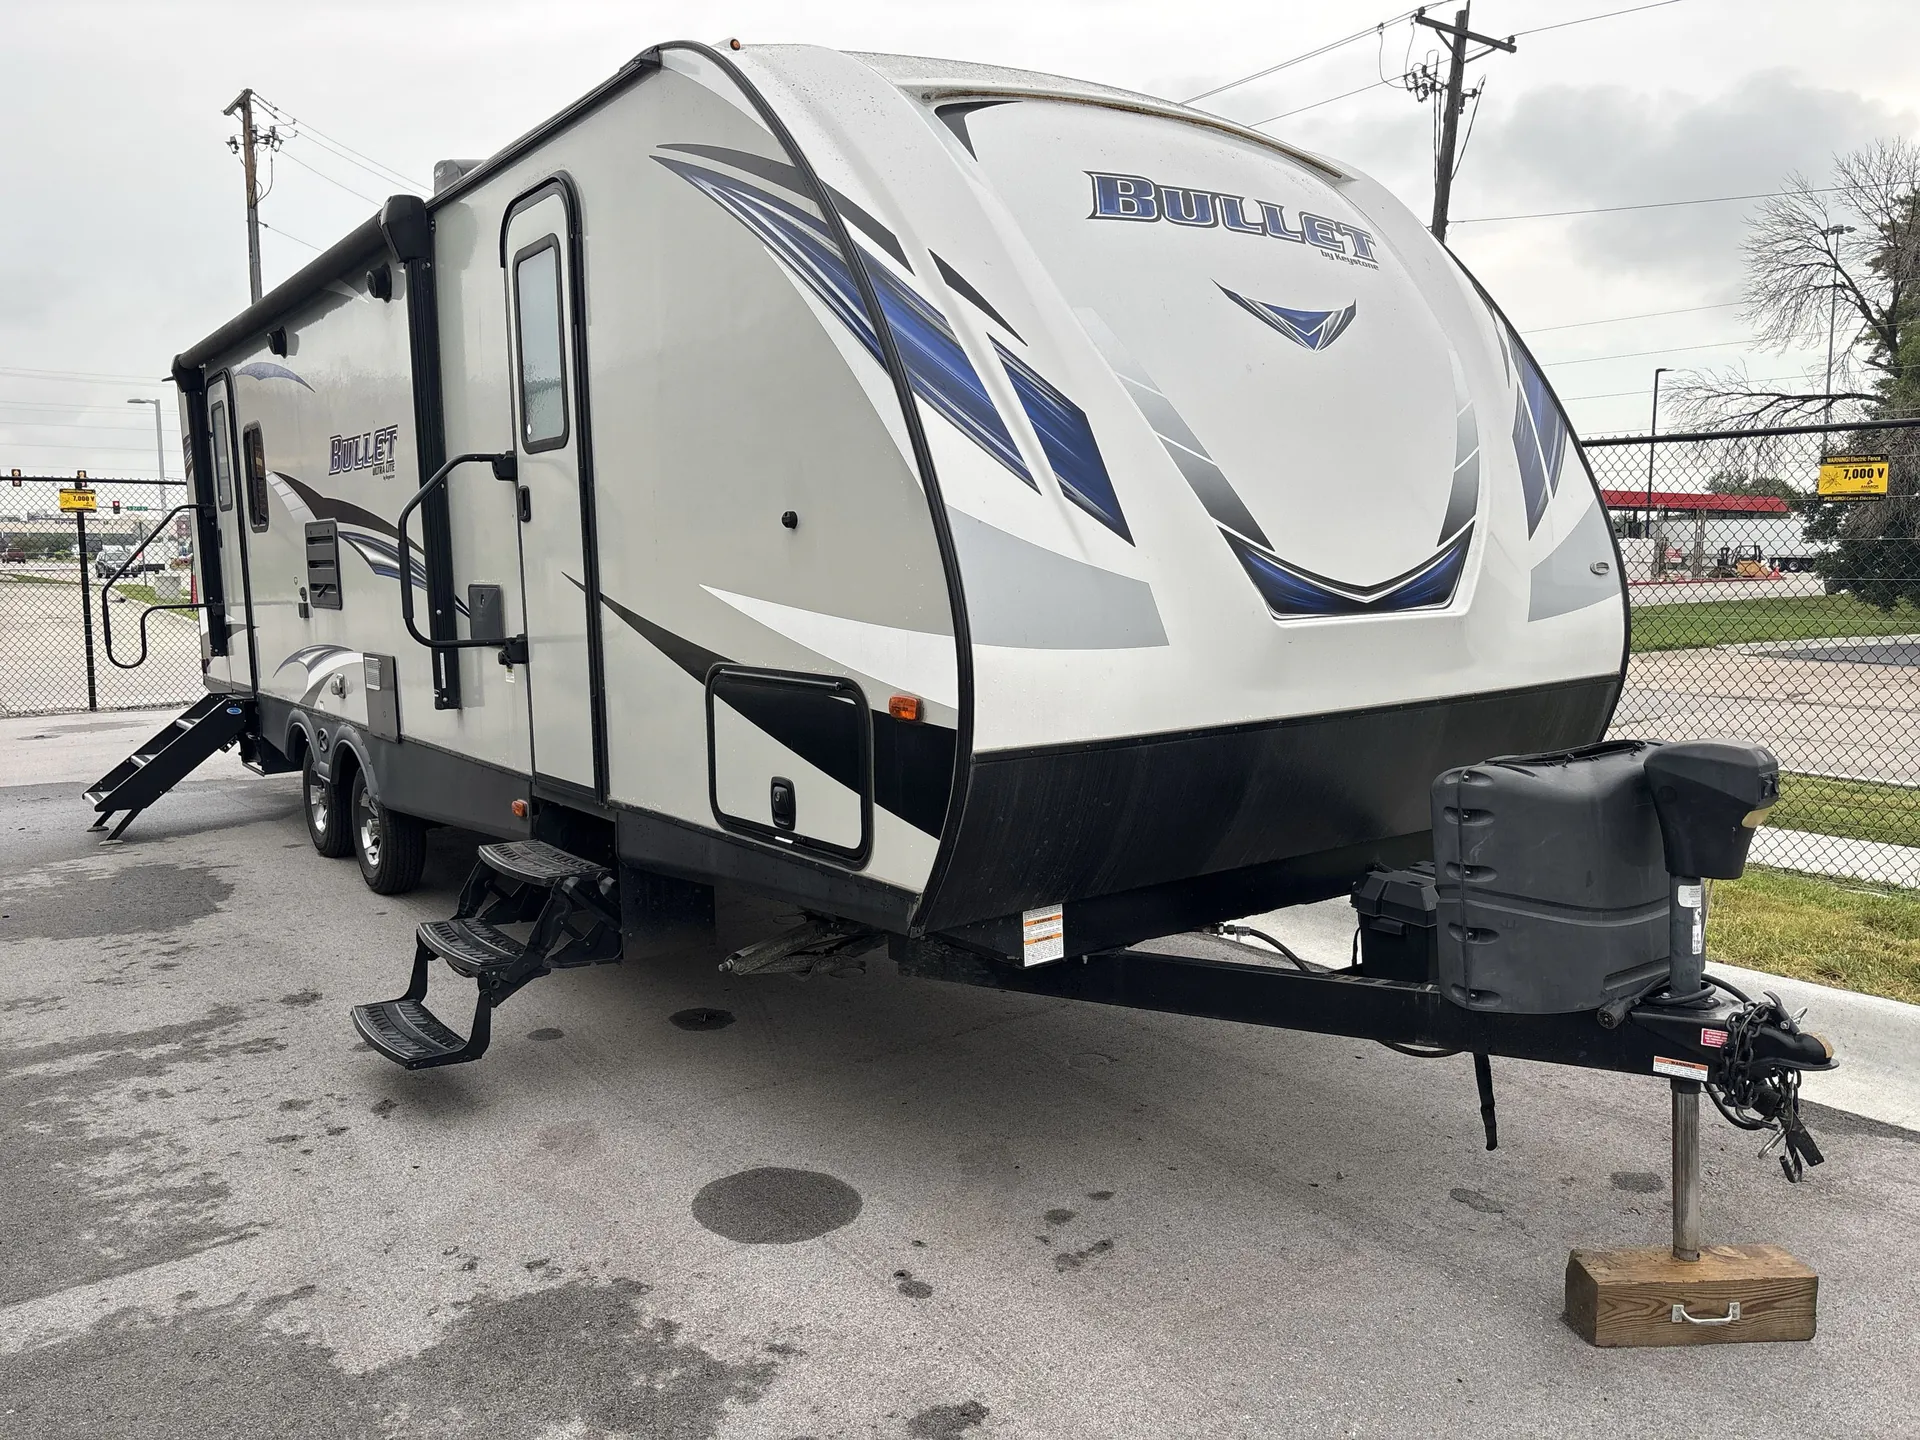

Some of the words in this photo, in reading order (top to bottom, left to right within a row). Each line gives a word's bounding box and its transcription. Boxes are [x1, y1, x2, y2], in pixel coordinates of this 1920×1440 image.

[1082, 170, 1379, 264] BULLET
[1320, 249, 1335, 261] by
[1334, 252, 1380, 271] Keystone
[328, 424, 398, 476] BULLET
[1843, 468, 1874, 480] 7,000
[1877, 467, 1885, 479] V
